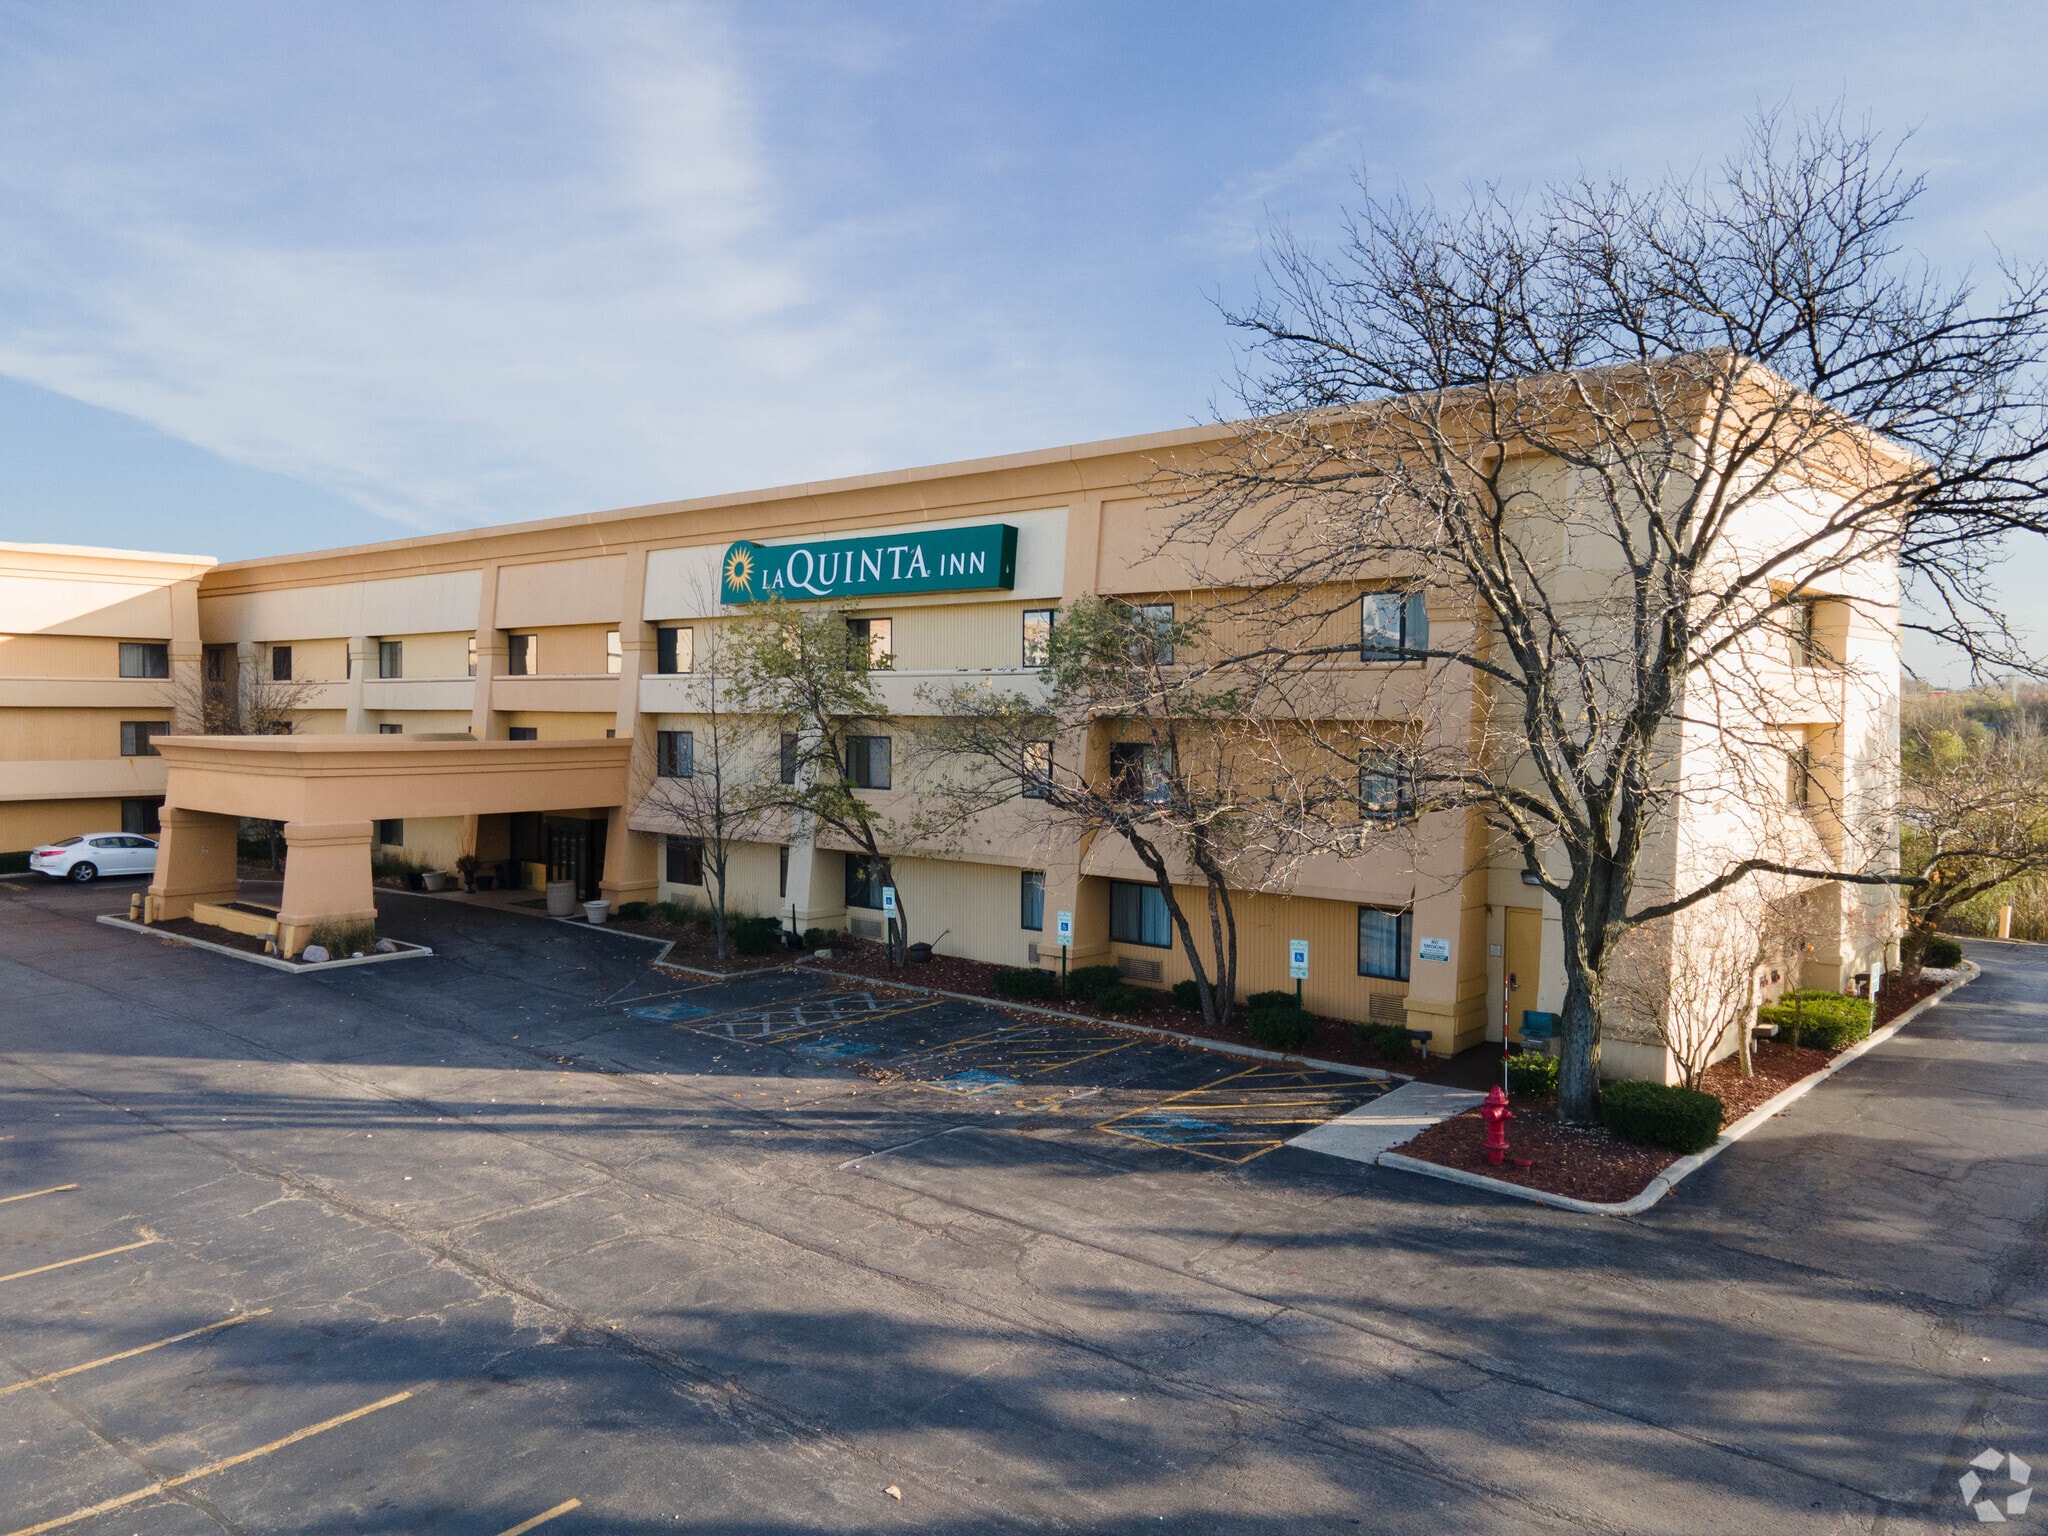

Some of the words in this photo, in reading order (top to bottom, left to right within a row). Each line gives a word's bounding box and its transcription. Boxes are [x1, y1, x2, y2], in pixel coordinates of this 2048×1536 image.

[762, 568, 784, 589] LA
[786, 544, 929, 595] QUINTA
[940, 551, 985, 576] INN
